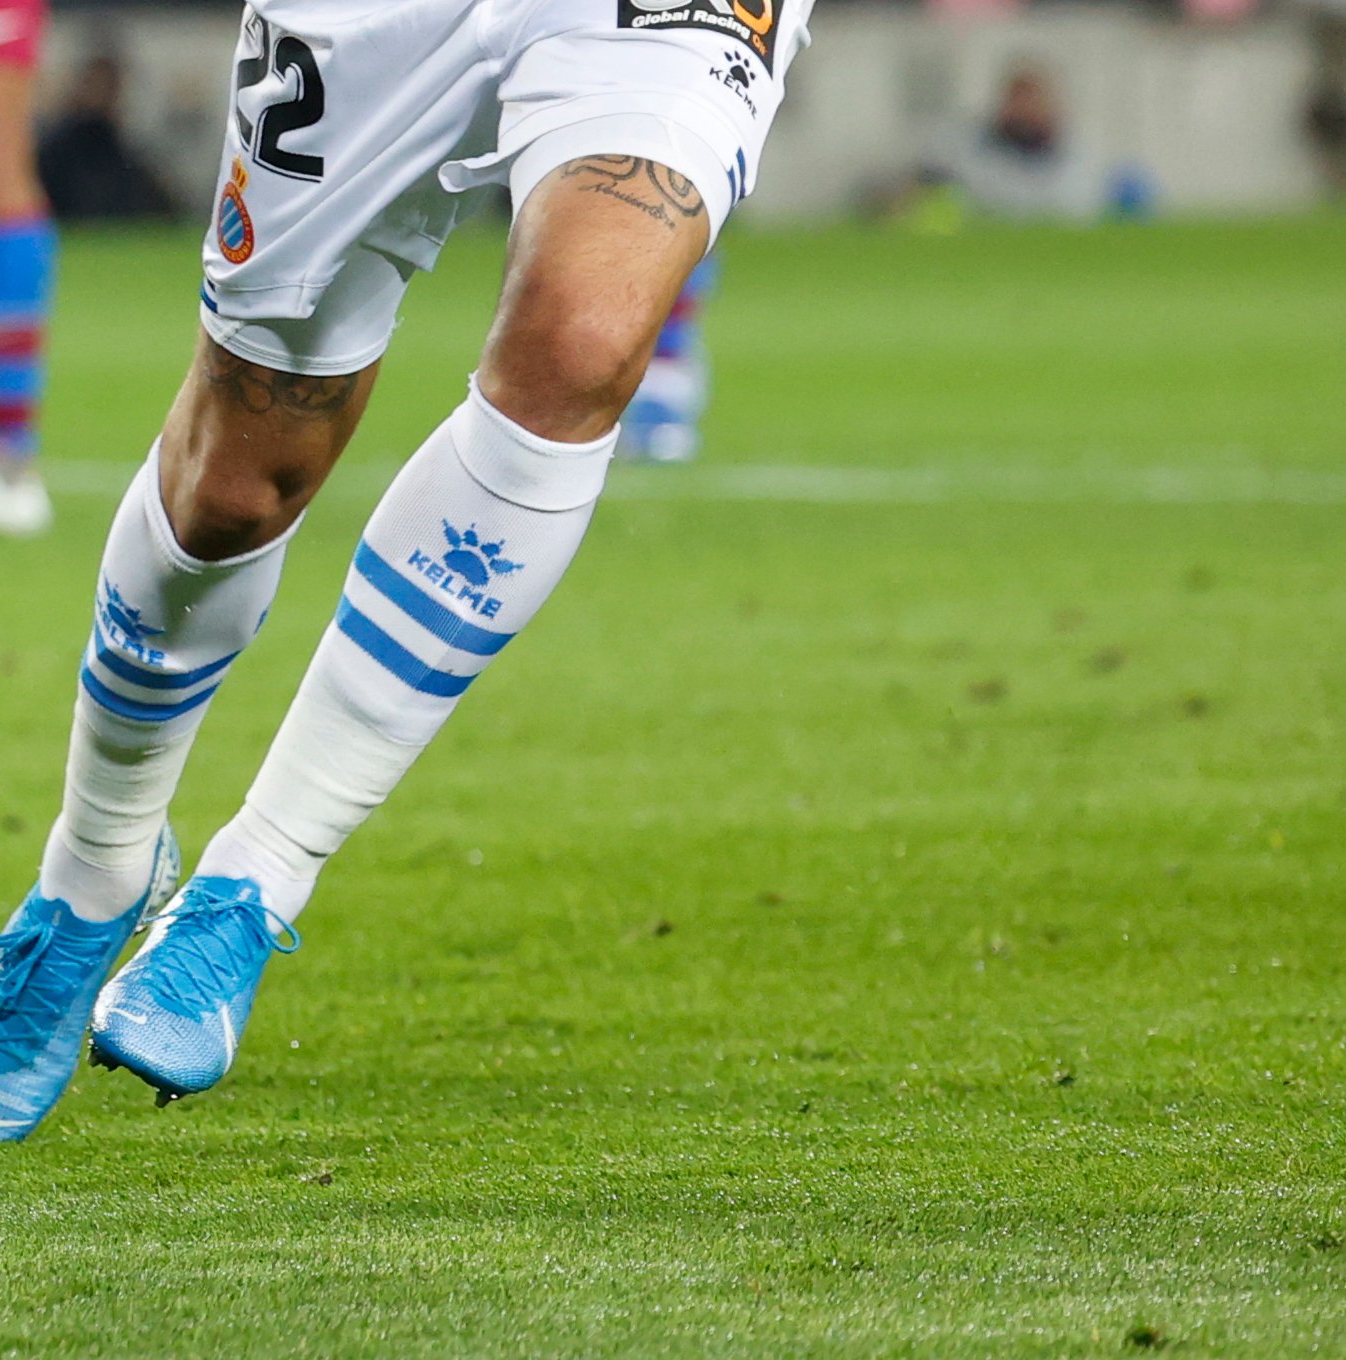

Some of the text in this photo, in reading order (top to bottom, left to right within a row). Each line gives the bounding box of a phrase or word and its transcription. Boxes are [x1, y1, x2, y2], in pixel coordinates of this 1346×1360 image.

[631, 9, 691, 28] Global
[693, 9, 751, 40] Racing
[709, 67, 758, 120] KELME
[407, 547, 503, 620] KELME
